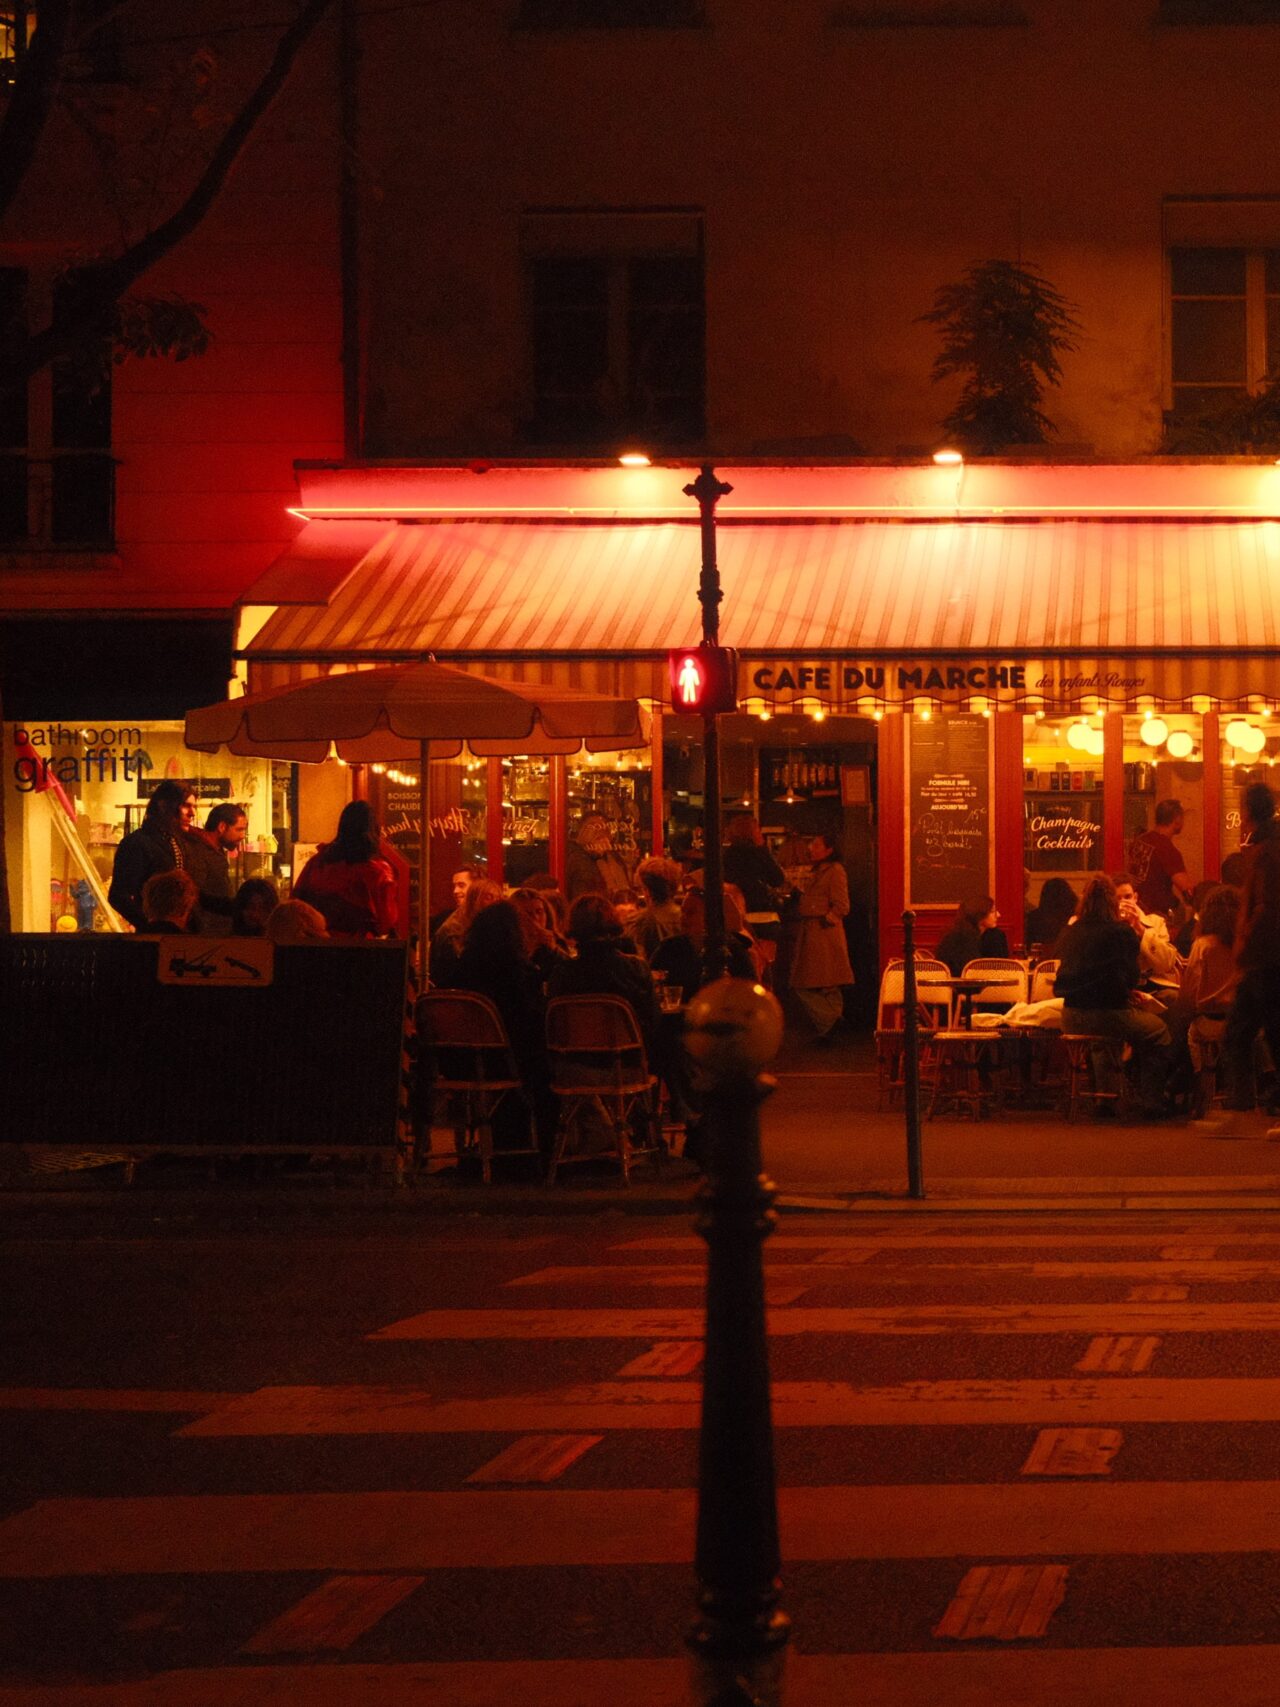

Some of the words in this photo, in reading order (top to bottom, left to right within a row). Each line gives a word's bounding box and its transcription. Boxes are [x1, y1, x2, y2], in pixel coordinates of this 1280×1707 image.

[753, 666, 831, 691] CAFE
[844, 666, 885, 691] DU
[898, 665, 1027, 691] MARCHE
[1035, 674, 1054, 689] des
[1058, 672, 1101, 693] enfants
[1102, 672, 1146, 690] Rouges
[14, 723, 143, 746] bathroom
[14, 748, 144, 793] graffiti
[1030, 816, 1102, 834] Champagne
[1037, 834, 1095, 850] Cocktails
